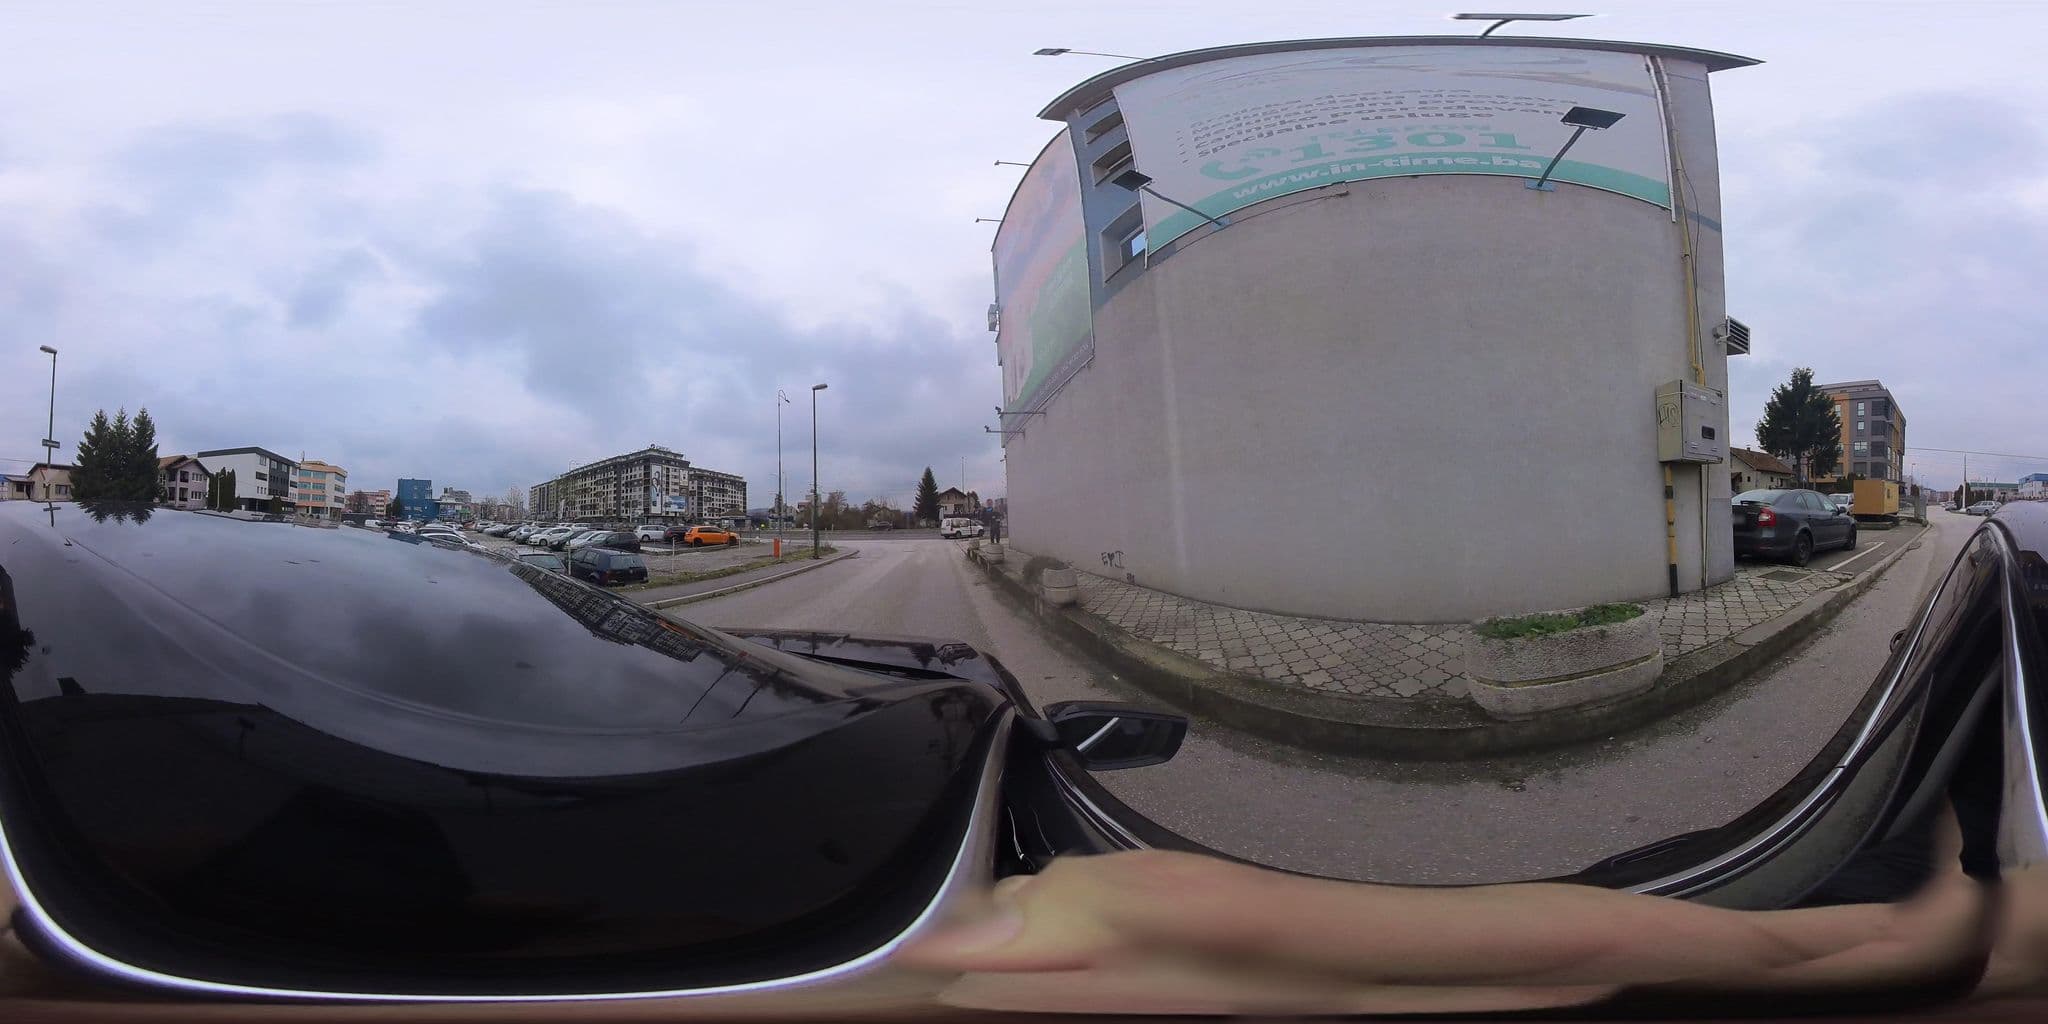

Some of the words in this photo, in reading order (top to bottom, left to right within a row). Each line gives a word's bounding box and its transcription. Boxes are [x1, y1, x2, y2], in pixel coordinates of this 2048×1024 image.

[1418, 99, 1553, 108] prevoz
[1419, 93, 1579, 105] dostava
[1196, 116, 1318, 149] Carinsko
[1198, 119, 1349, 158] Specijalne
[1360, 112, 1495, 121] usluge
[1290, 131, 1532, 162] 1301
[1232, 155, 1543, 199] www.in-time.ba
